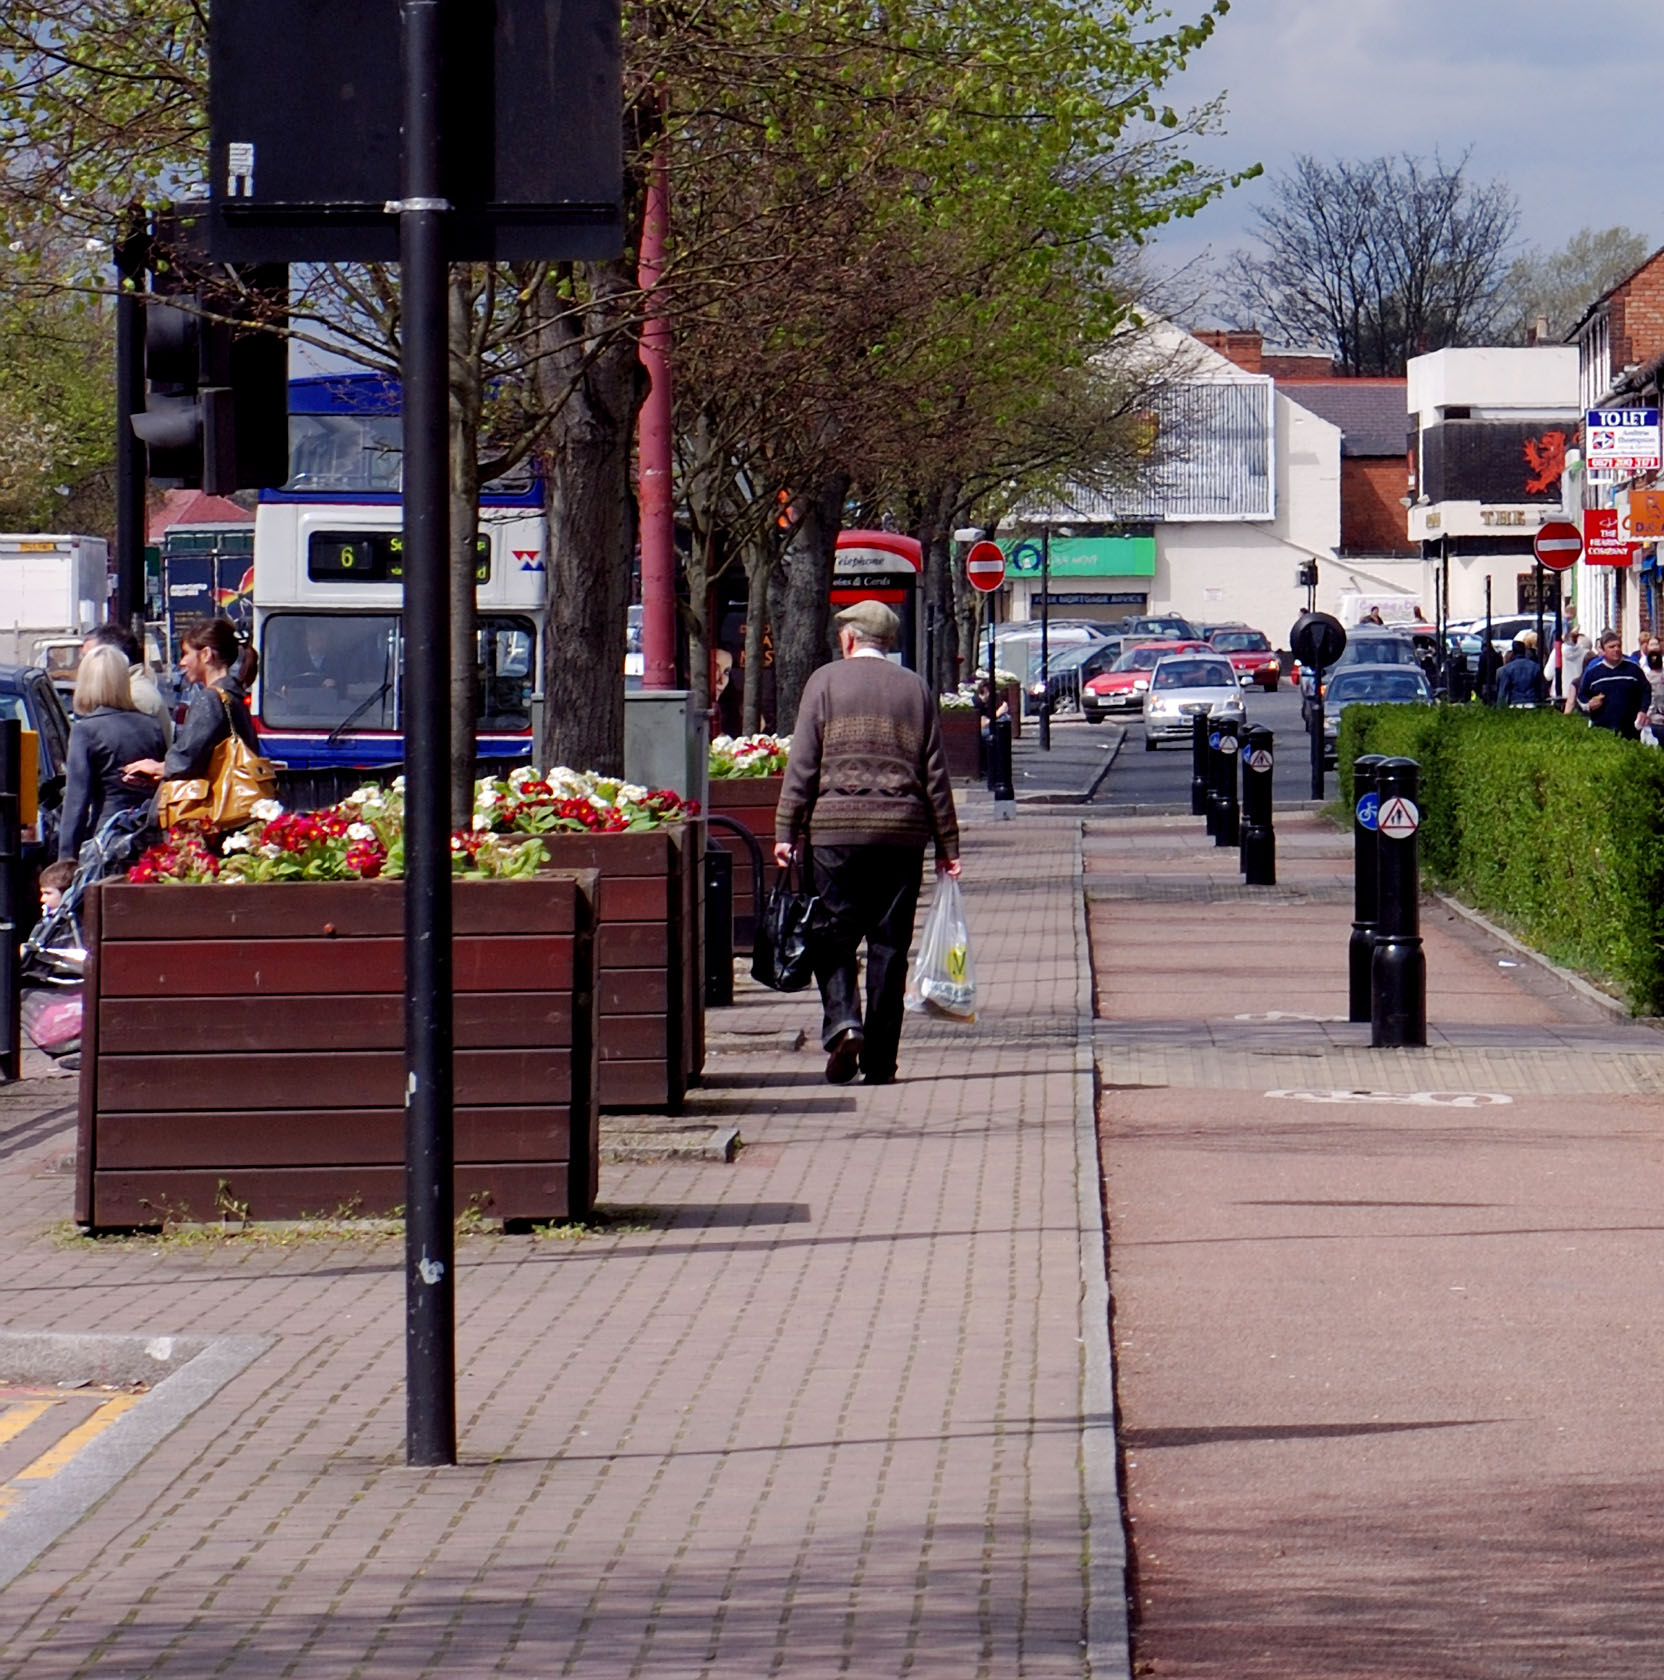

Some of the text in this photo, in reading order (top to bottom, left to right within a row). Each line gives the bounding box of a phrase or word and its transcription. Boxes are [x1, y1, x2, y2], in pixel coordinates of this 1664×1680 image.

[1598, 411, 1648, 426] TO LET
[1481, 510, 1525, 526] THE
[1600, 529, 1617, 538] THE
[340, 547, 353, 568] 6
